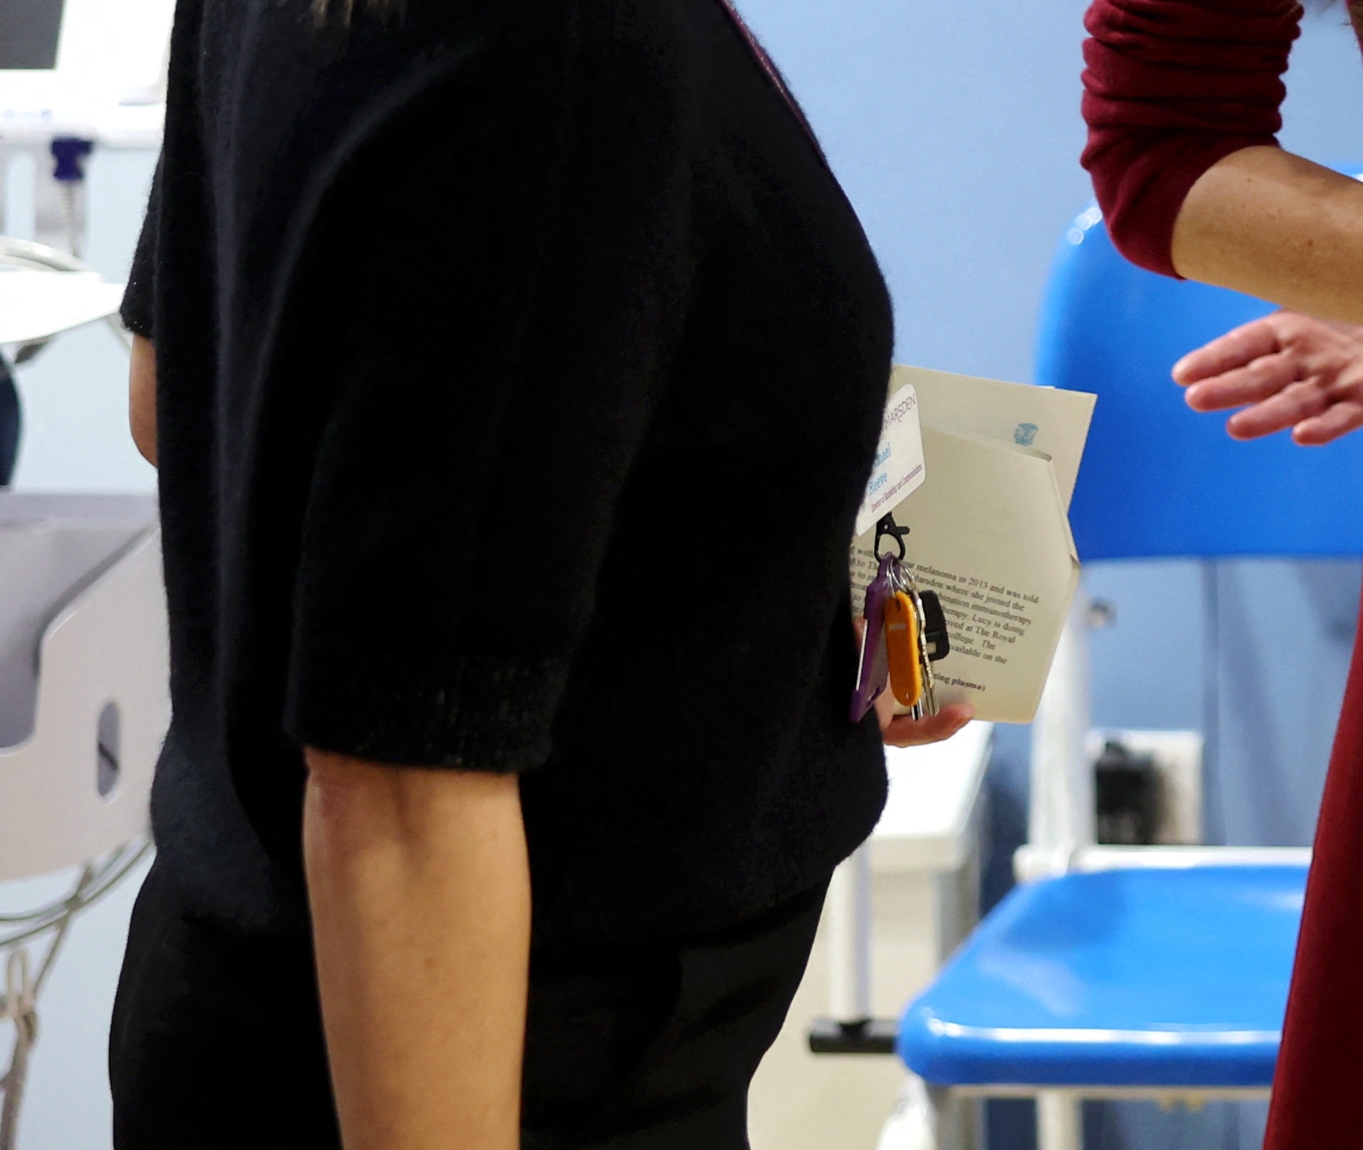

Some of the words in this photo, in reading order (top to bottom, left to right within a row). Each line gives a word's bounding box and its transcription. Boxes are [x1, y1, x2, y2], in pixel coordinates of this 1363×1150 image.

[916, 563, 957, 581] melanoma
[989, 584, 1005, 594] and
[1006, 589, 1021, 599] was
[1023, 593, 1039, 604] told
[938, 592, 970, 608] bination
[945, 583, 969, 596] where
[971, 590, 984, 600] she
[985, 594, 1011, 608] joined
[1012, 601, 1025, 611] the
[972, 614, 991, 626] Lucy
[1003, 622, 1025, 637] doing
[975, 626, 990, 637] The
[992, 631, 1016, 644] Royal
[950, 644, 981, 658] vailable
[982, 653, 993, 661] on
[994, 655, 1008, 664] the
[981, 639, 996, 650] The
